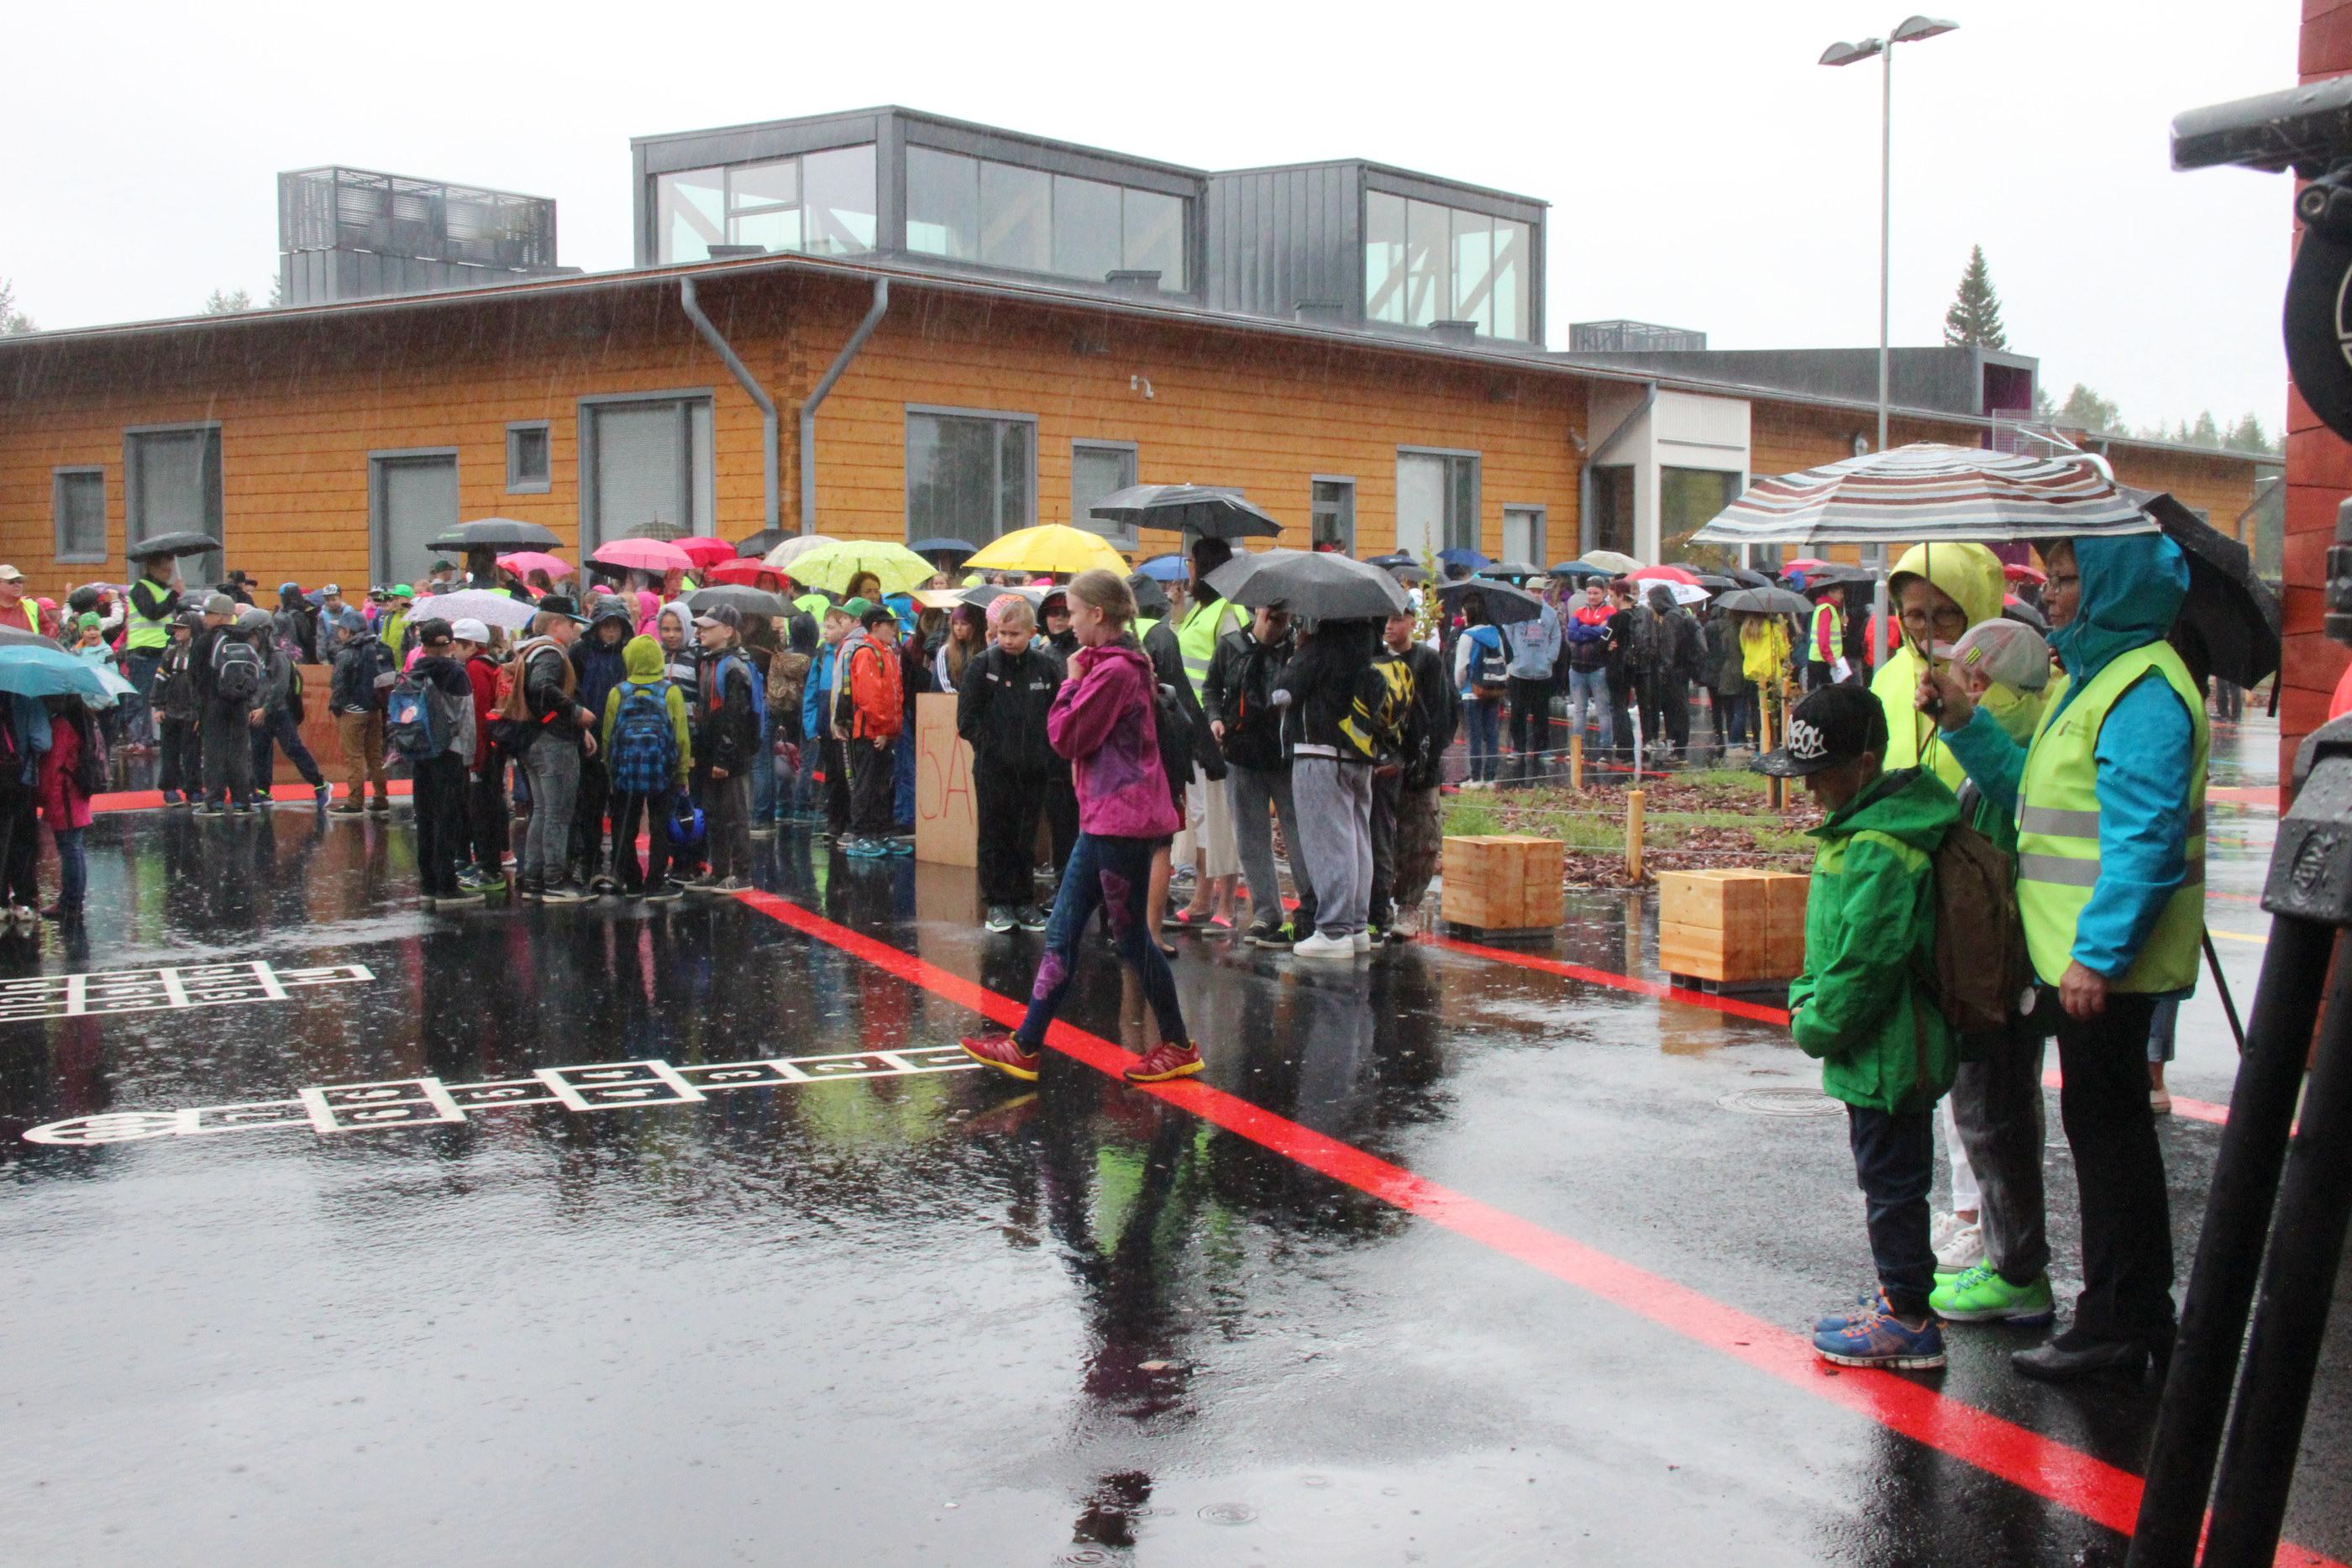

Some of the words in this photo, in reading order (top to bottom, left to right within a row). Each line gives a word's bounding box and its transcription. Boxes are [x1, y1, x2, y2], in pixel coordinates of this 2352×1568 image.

[919, 726, 974, 826] 5A
[0, 994, 45, 1004] 2
[202, 991, 248, 1000] 5
[106, 999, 154, 1008] 3
[815, 1061, 868, 1072] 2
[583, 1070, 633, 1078] 4
[709, 1070, 761, 1080] 3
[344, 1089, 401, 1099] 6
[470, 1088, 526, 1099] 5
[596, 1088, 654, 1097] 4
[224, 1112, 281, 1123] 7
[353, 1109, 411, 1120] 6
